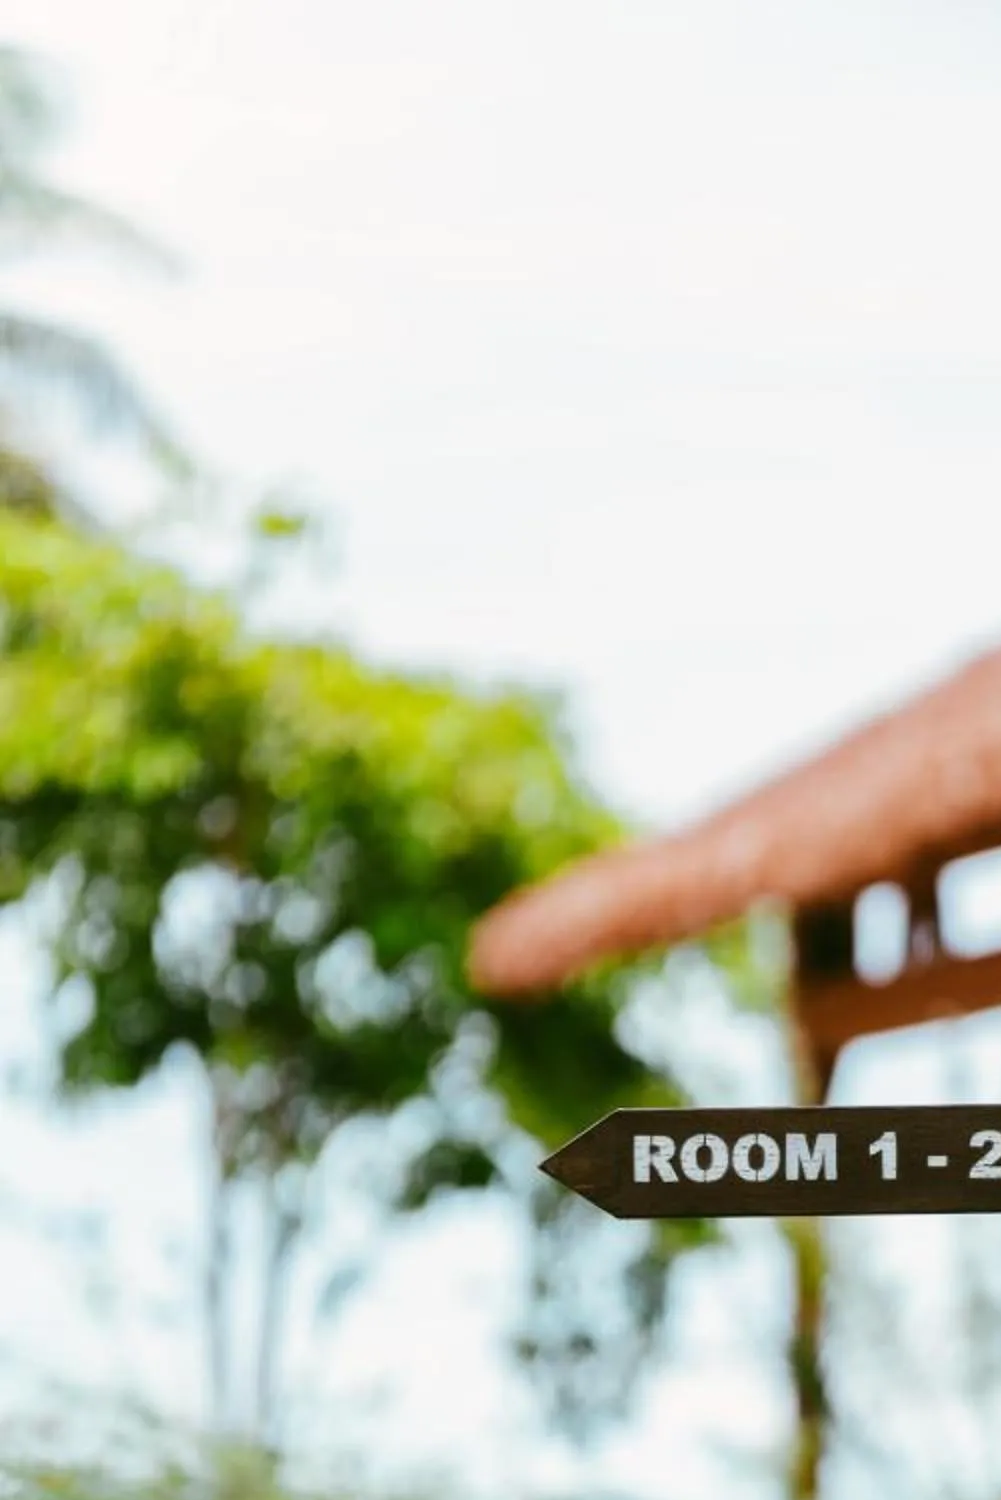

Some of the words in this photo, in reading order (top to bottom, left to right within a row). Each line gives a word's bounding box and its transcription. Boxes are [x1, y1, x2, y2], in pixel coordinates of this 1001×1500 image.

[633, 1133, 837, 1182] ROOM
[869, 1131, 897, 1180] 1
[927, 1155, 948, 1168] -
